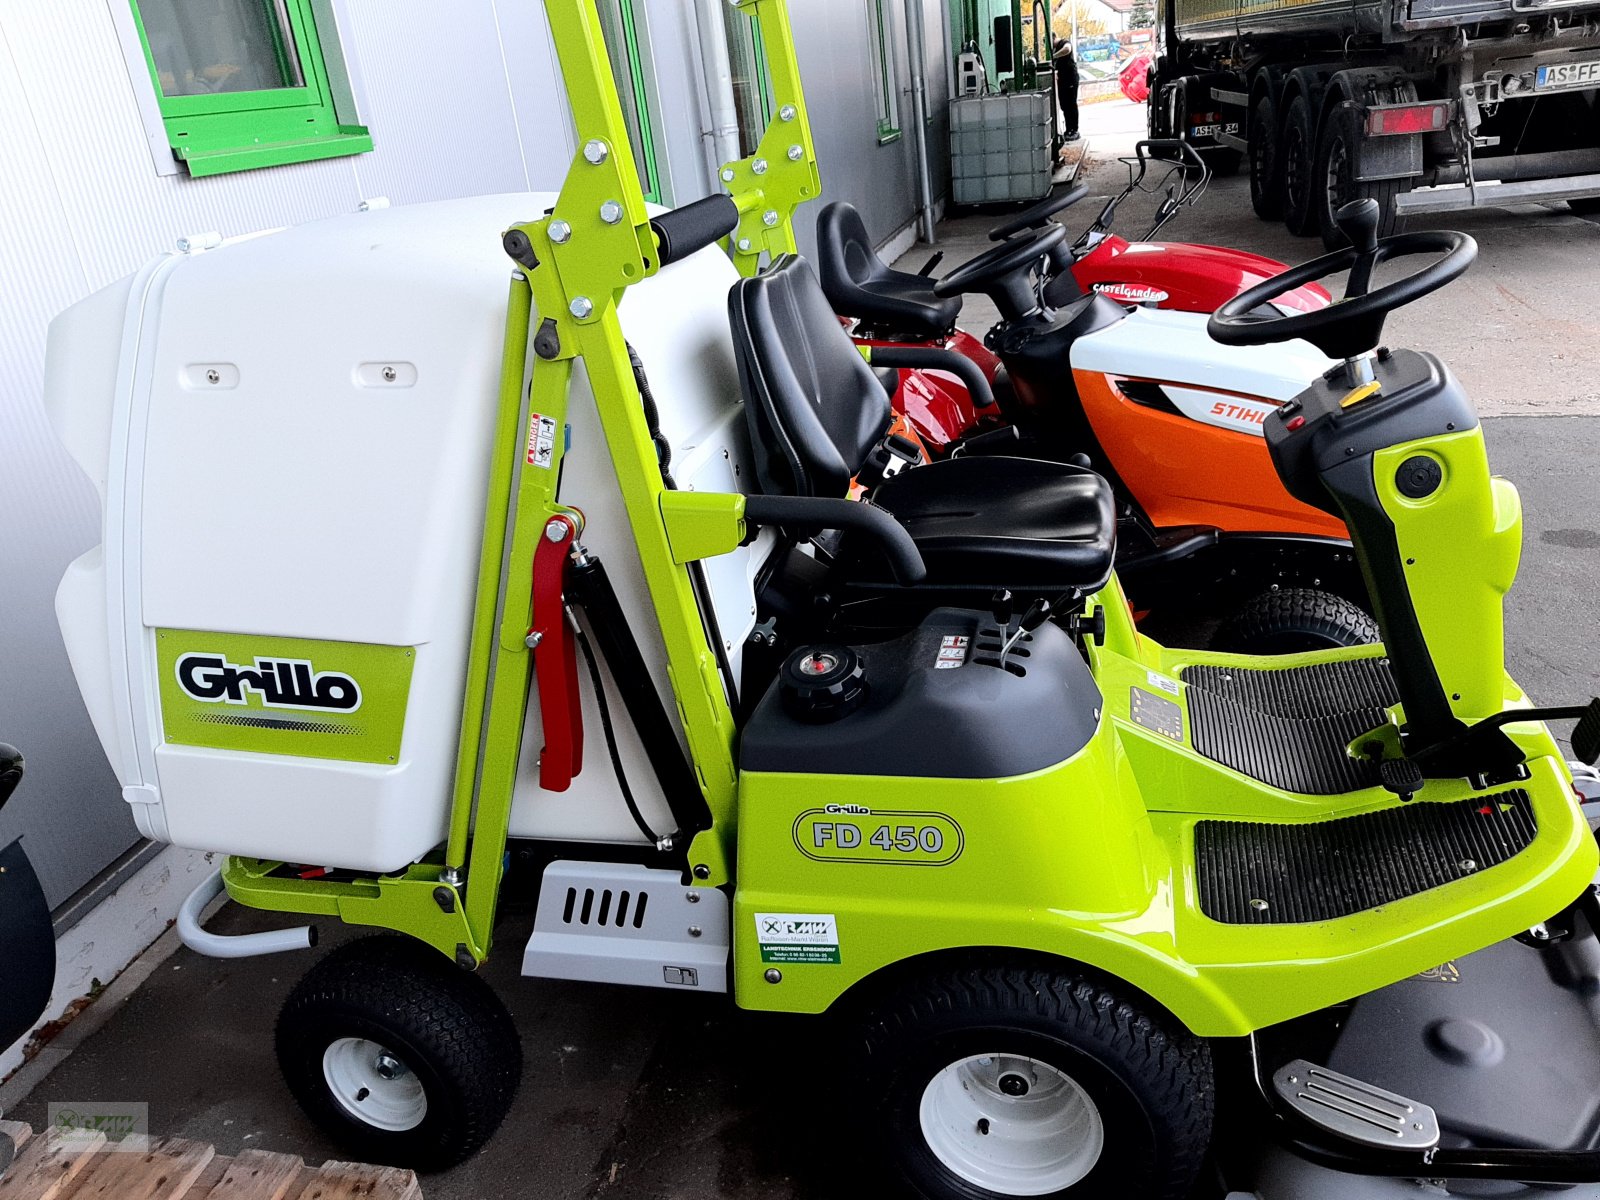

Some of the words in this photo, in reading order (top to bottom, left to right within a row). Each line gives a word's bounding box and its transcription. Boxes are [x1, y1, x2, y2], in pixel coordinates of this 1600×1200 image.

[1547, 67, 1568, 83] AS
[1210, 402, 1267, 424] STIHL
[529, 418, 540, 449] DANGER
[176, 654, 361, 711] Grillo
[825, 804, 870, 815] Grillo
[812, 822, 862, 849] FD
[870, 825, 943, 853] 450
[784, 921, 831, 934] RMW
